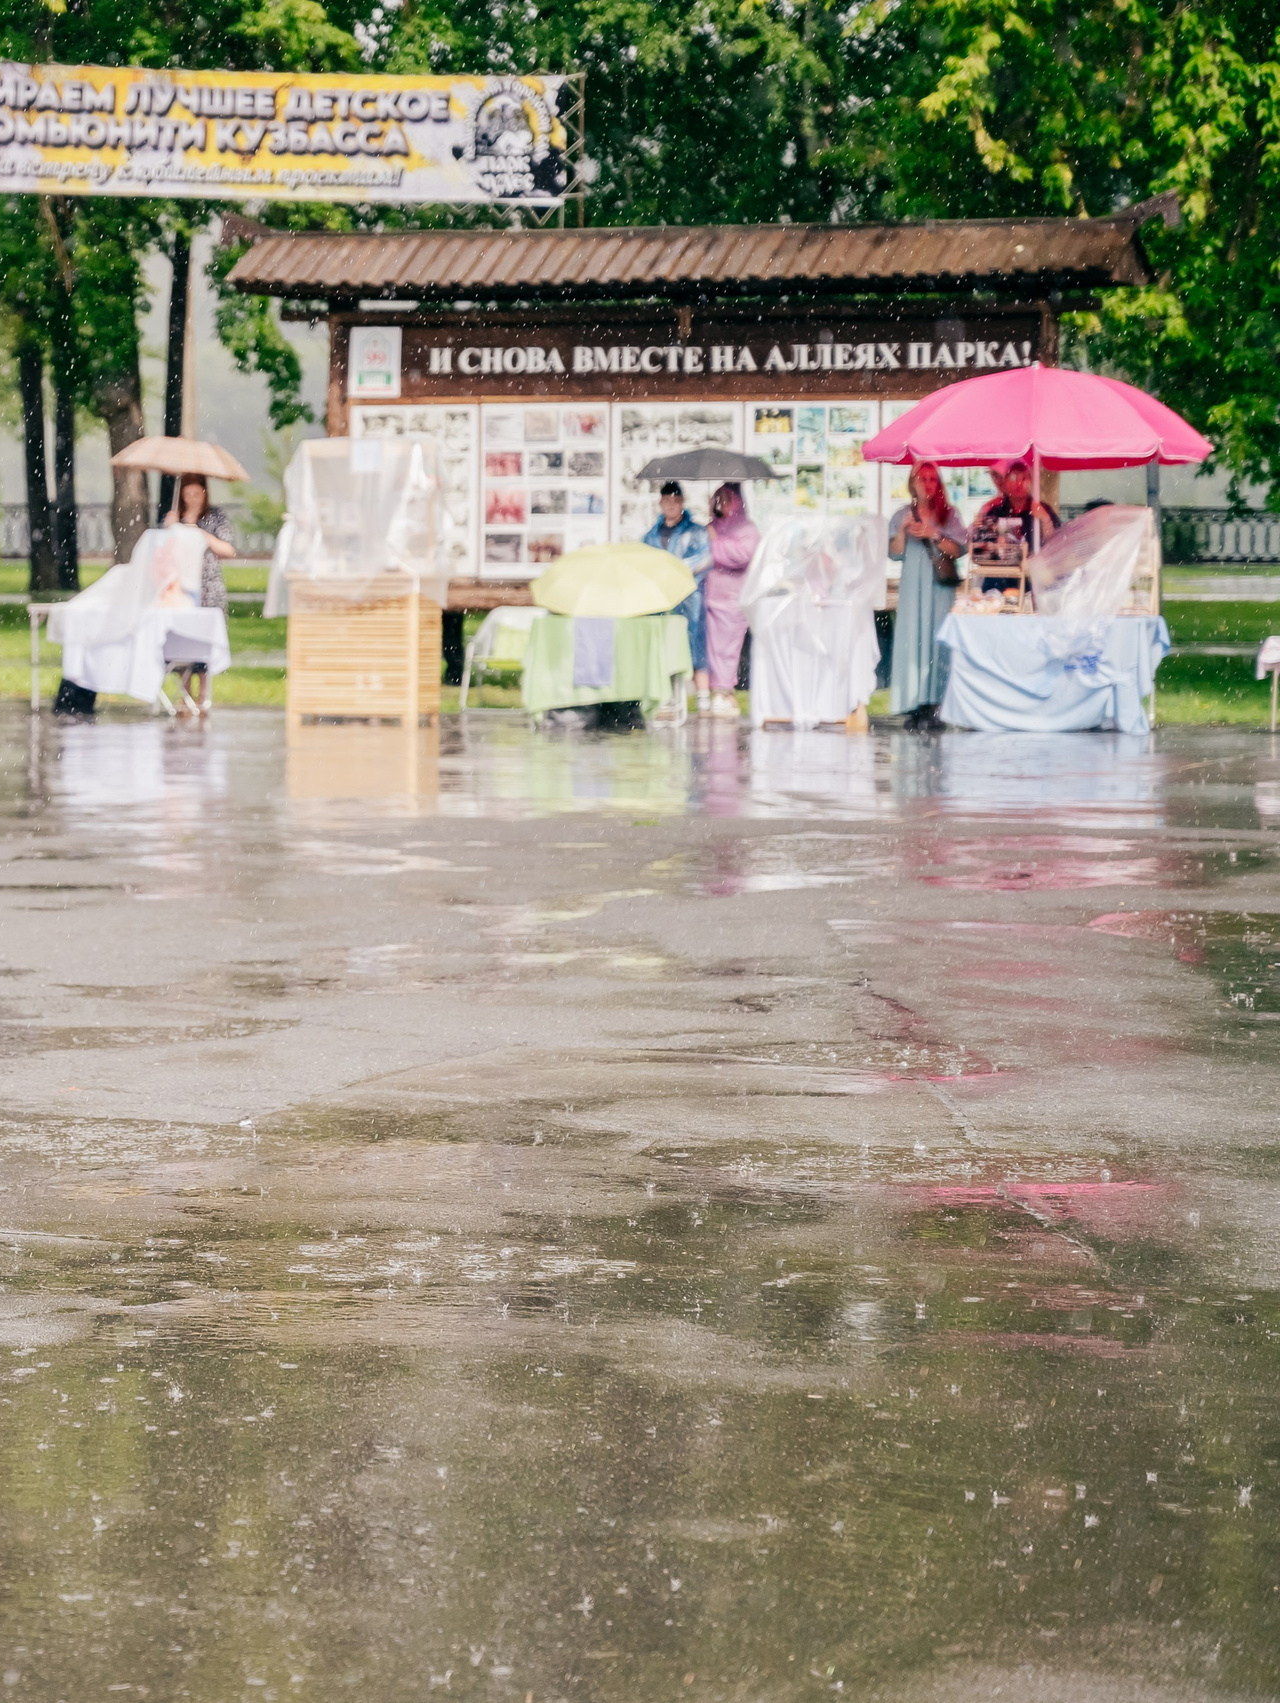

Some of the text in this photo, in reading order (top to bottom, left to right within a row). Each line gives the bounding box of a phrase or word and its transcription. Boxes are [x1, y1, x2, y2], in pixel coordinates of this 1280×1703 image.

[124, 83, 276, 120] ЛУЧШЕЕ
[283, 87, 451, 123] ДЕТСКОЕ
[216, 119, 410, 157] КУЗБАССА
[429, 339, 1033, 374] И СНОВА ВМЕСТЕ НА АЛЛЕЯХ ПАРКА!
